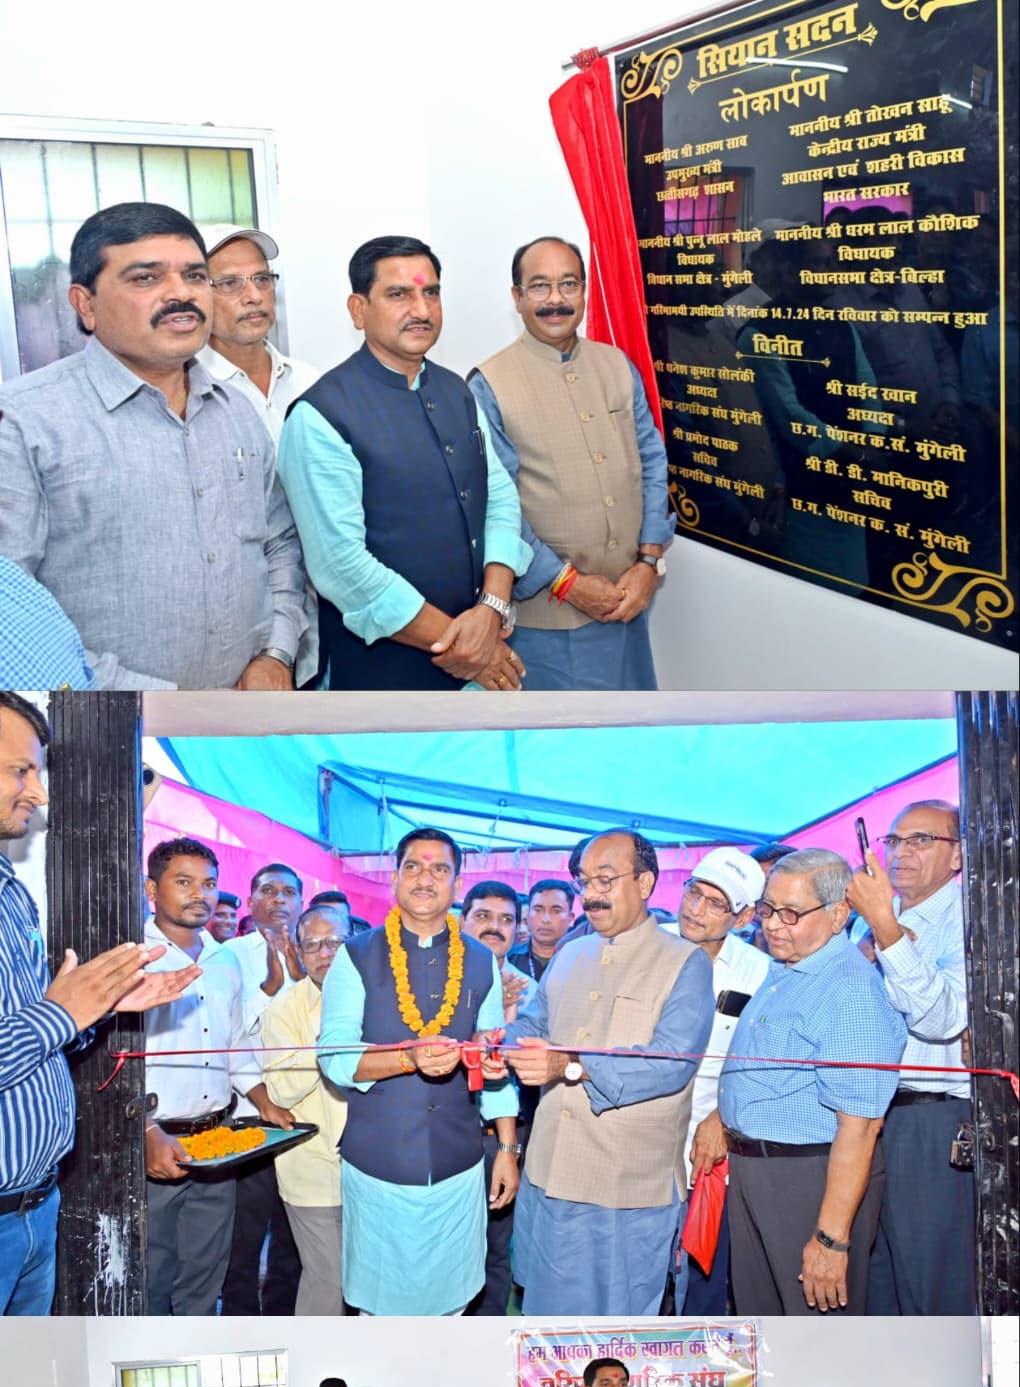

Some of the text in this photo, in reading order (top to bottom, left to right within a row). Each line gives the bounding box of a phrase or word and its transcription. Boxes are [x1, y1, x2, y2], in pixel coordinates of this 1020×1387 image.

[696, 3, 859, 79] सियान सदन
[719, 69, 830, 123] लोकार्पण
[789, 94, 953, 137] माननीय श्री तोखन साहू
[644, 135, 748, 165] माननीय श्री अरुण साव
[807, 123, 927, 158] केन्द्रीय राज्य मंत्री
[665, 159, 722, 182] उपमुख्य मंत्री
[782, 147, 966, 186] आवासन एवं शहरी विकास
[656, 181, 735, 202] छत्तीसगढ़ शासन
[823, 182, 911, 204] भारत सरकार
[638, 235, 671, 249] माननीय
[672, 233, 684, 247] श्री
[706, 232, 730, 245] लाल
[731, 227, 762, 243] मोहले
[775, 224, 823, 242] माननीय
[825, 222, 843, 239] श्री
[878, 220, 915, 235] लाल
[917, 213, 981, 232] कौशिक
[676, 253, 716, 266] विधायक
[837, 246, 896, 261] विधायक
[647, 272, 673, 285] विधान
[675, 274, 693, 285] सभा
[695, 271, 713, 285] क्षेत्र
[721, 270, 754, 288] मुंगेली
[800, 270, 866, 285] विधानसभा
[726, 304, 736, 318] में
[736, 305, 768, 319] दिनांक
[771, 306, 810, 320] 14.7.24
[812, 307, 835, 321] दिन
[838, 307, 877, 322] रविवार
[880, 308, 899, 322] को
[903, 311, 950, 324] सम्पन्न
[954, 312, 988, 328] हुआ
[752, 333, 804, 356] विनीत
[690, 365, 716, 380] कुमार
[718, 366, 756, 383] सोलंकी
[686, 384, 718, 399] अध्यक्ष
[826, 379, 917, 404] श्री सईद खान
[675, 401, 710, 416] नागरिक
[711, 405, 729, 420] संघ
[729, 408, 763, 426] मुंगेली
[847, 407, 895, 426] अध्यक्ष
[672, 427, 740, 452] श्री प्रमोद पाठक
[790, 421, 822, 439] छ.ग.
[826, 424, 866, 447] पेंशनर
[914, 439, 967, 463] मुंगेली
[691, 450, 718, 467] सचिव
[678, 466, 713, 484] नागरिक
[714, 475, 731, 490] संघ
[732, 479, 766, 499] मुंगेली
[805, 455, 949, 500] श्री डी. डी. मानिकपुरी
[852, 489, 892, 511] सचिव
[791, 498, 971, 555] छ.ग. पेंशनर क. सं. मुंगेली
[527, 1345, 547, 1362] हम
[551, 1342, 593, 1361] आपका
[597, 1336, 638, 1359] हार्दिक
[641, 1339, 685, 1357] स्वागत
